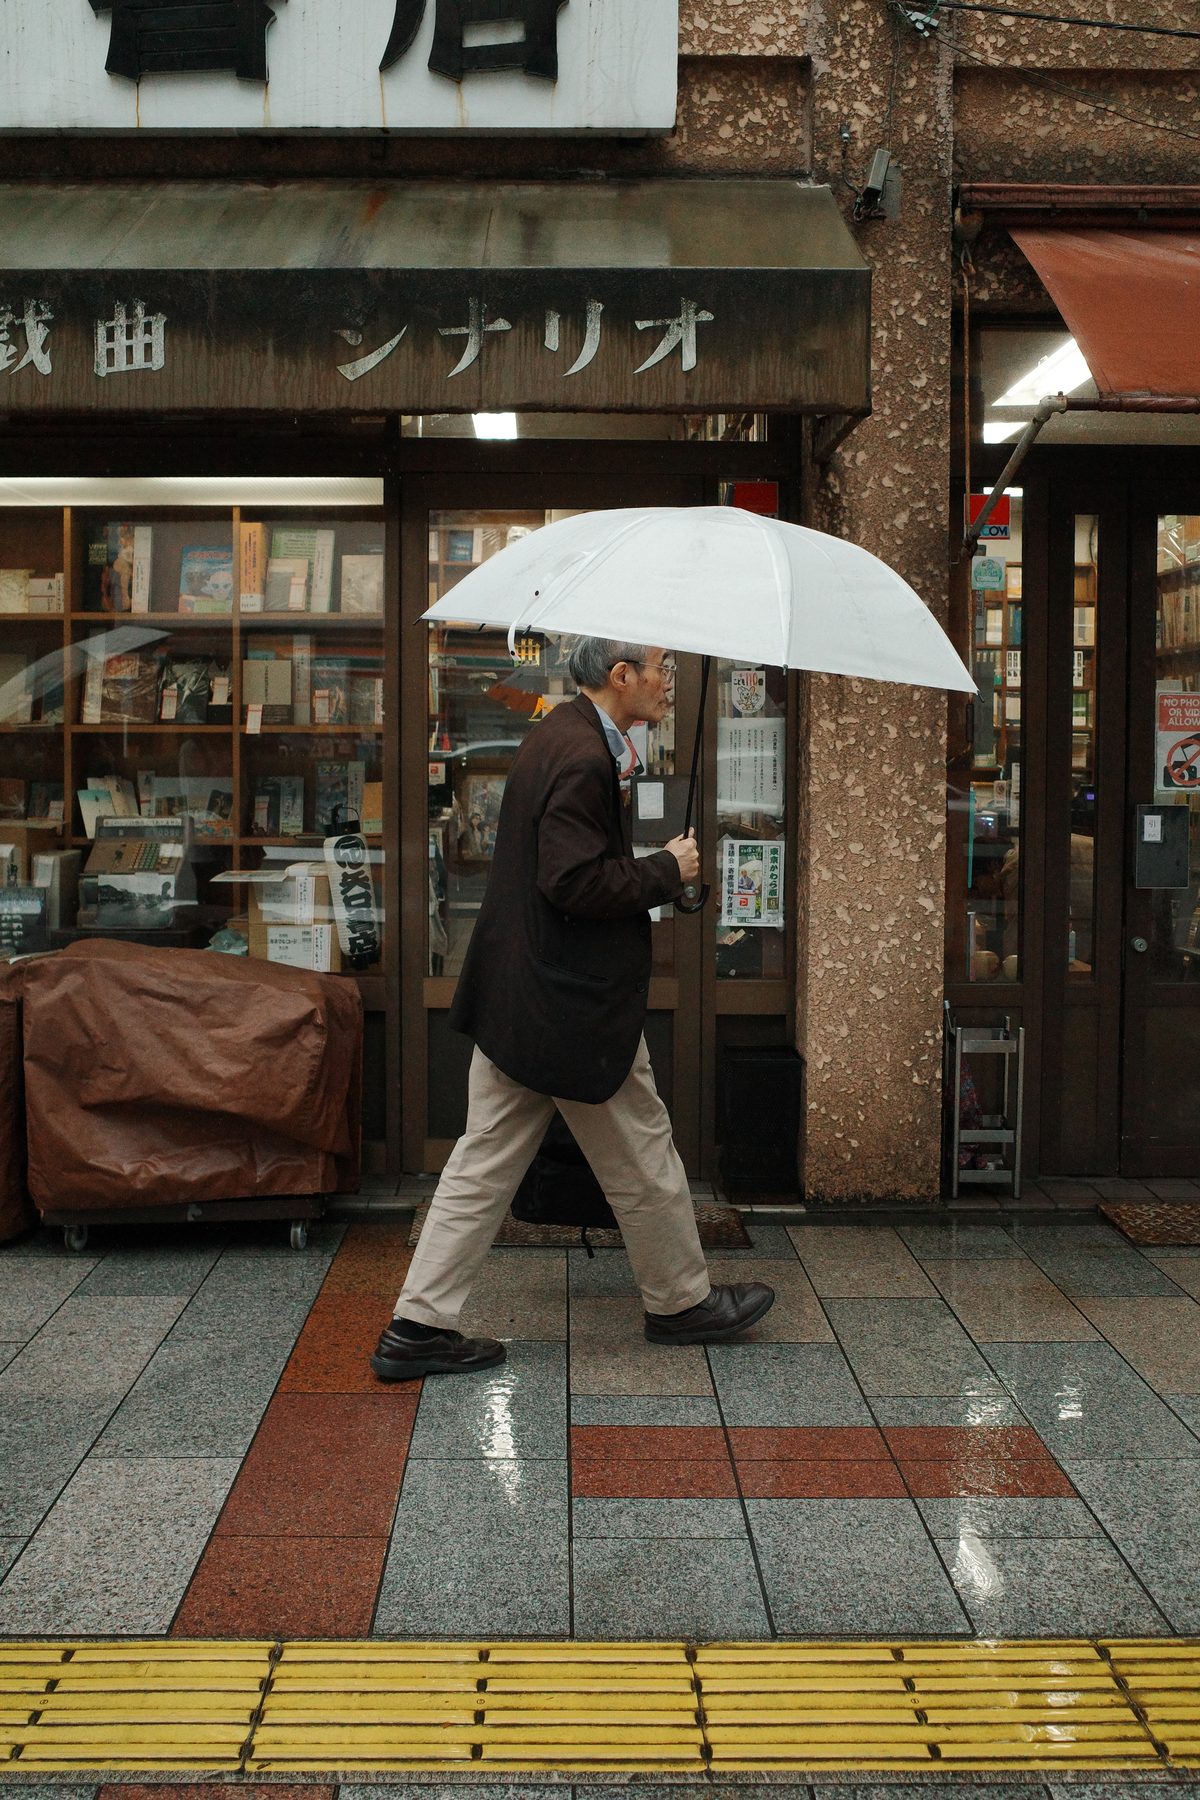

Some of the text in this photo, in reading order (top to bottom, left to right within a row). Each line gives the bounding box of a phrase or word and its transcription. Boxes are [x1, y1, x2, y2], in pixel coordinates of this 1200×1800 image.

[1163, 698, 1178, 707] NO
[1168, 707, 1182, 717] OR
[768, 847, 779, 896] 東京かわら版
[339, 869, 378, 954] 矢口書店
